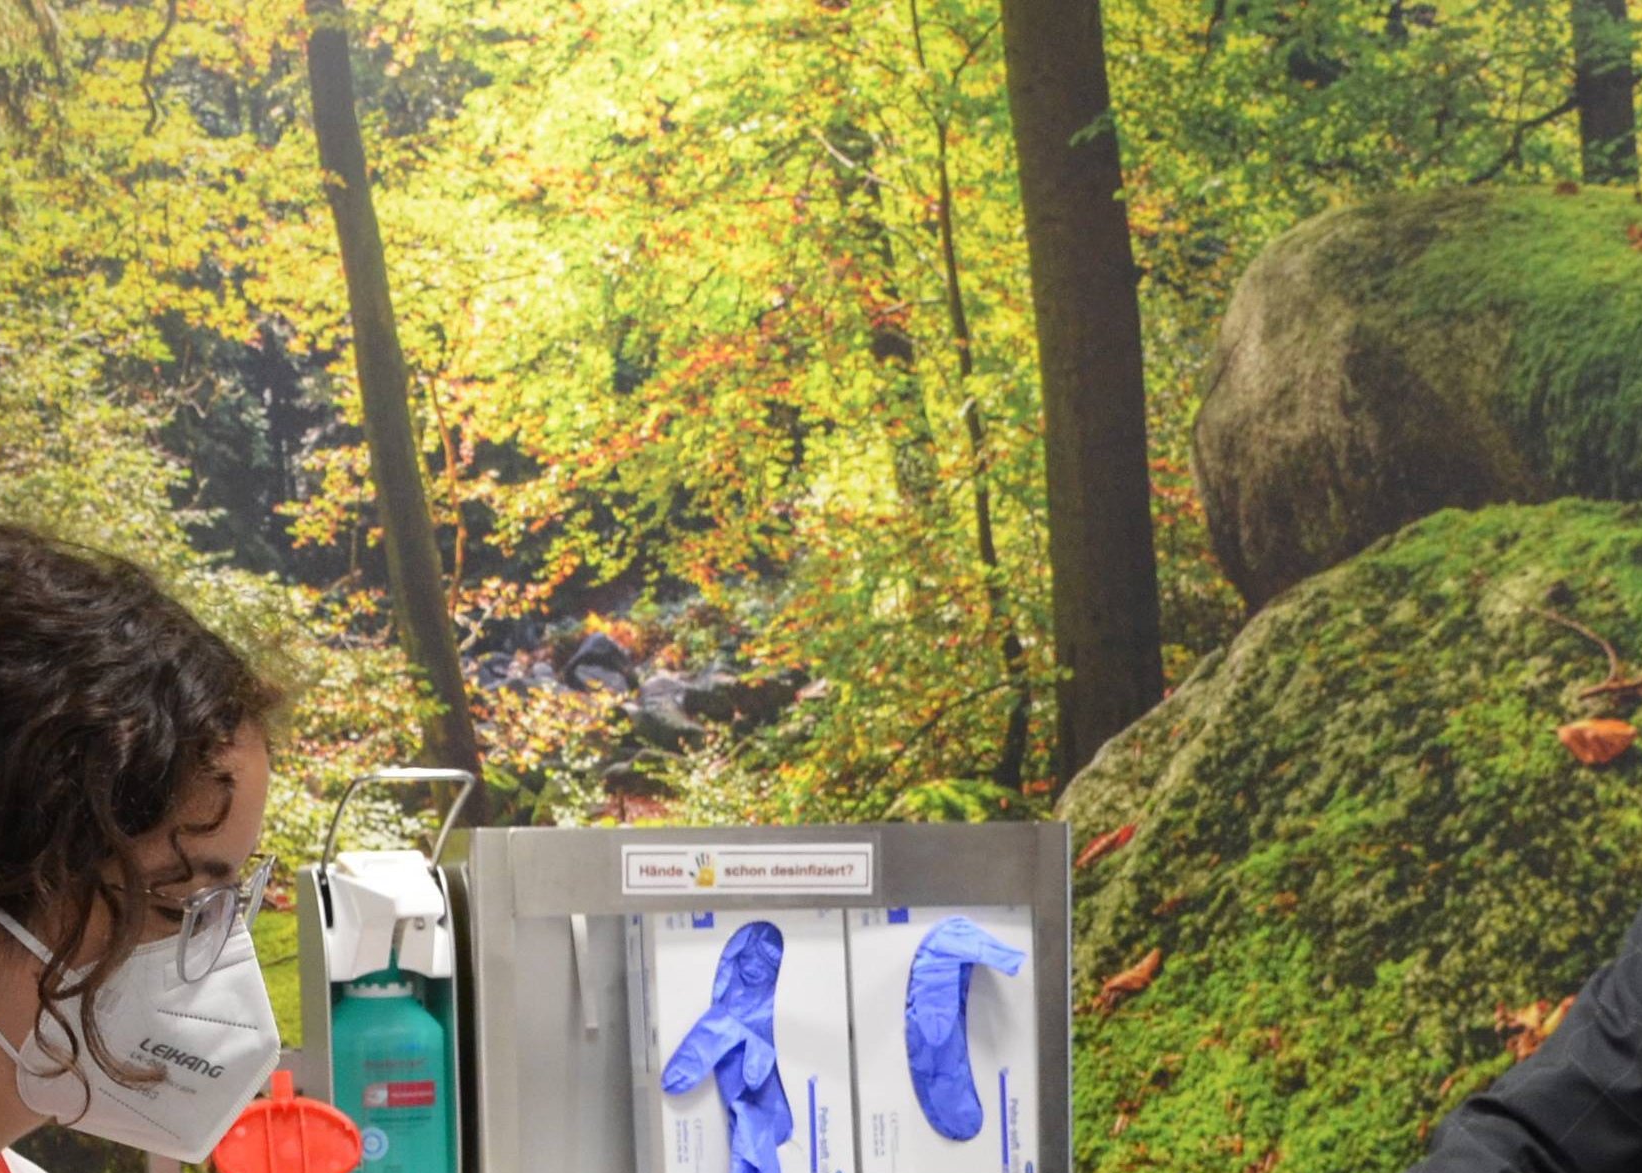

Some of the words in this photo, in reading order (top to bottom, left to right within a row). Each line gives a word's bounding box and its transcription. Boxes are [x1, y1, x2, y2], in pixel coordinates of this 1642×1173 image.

[639, 864, 684, 877] Hände
[724, 864, 767, 877] schon
[770, 864, 854, 877] desinfiziert?
[139, 1038, 225, 1079] LEIKANG
